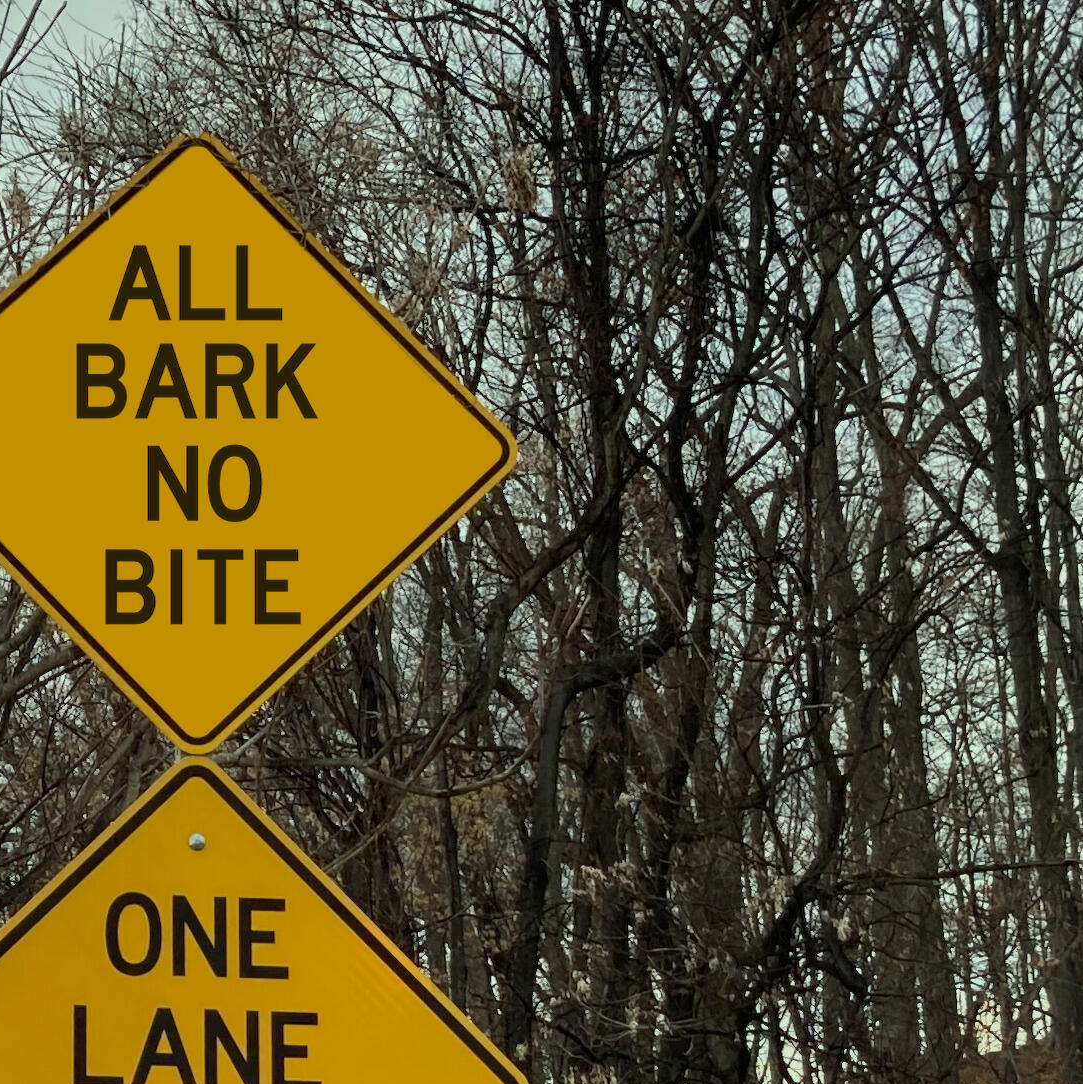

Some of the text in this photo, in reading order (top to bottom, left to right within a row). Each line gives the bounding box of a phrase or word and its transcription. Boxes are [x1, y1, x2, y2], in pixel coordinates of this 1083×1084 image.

[108, 245, 283, 321] ALL
[76, 343, 318, 419] BARK
[147, 444, 262, 523] NO
[105, 549, 301, 625] BITE
[105, 892, 289, 980] ONE
